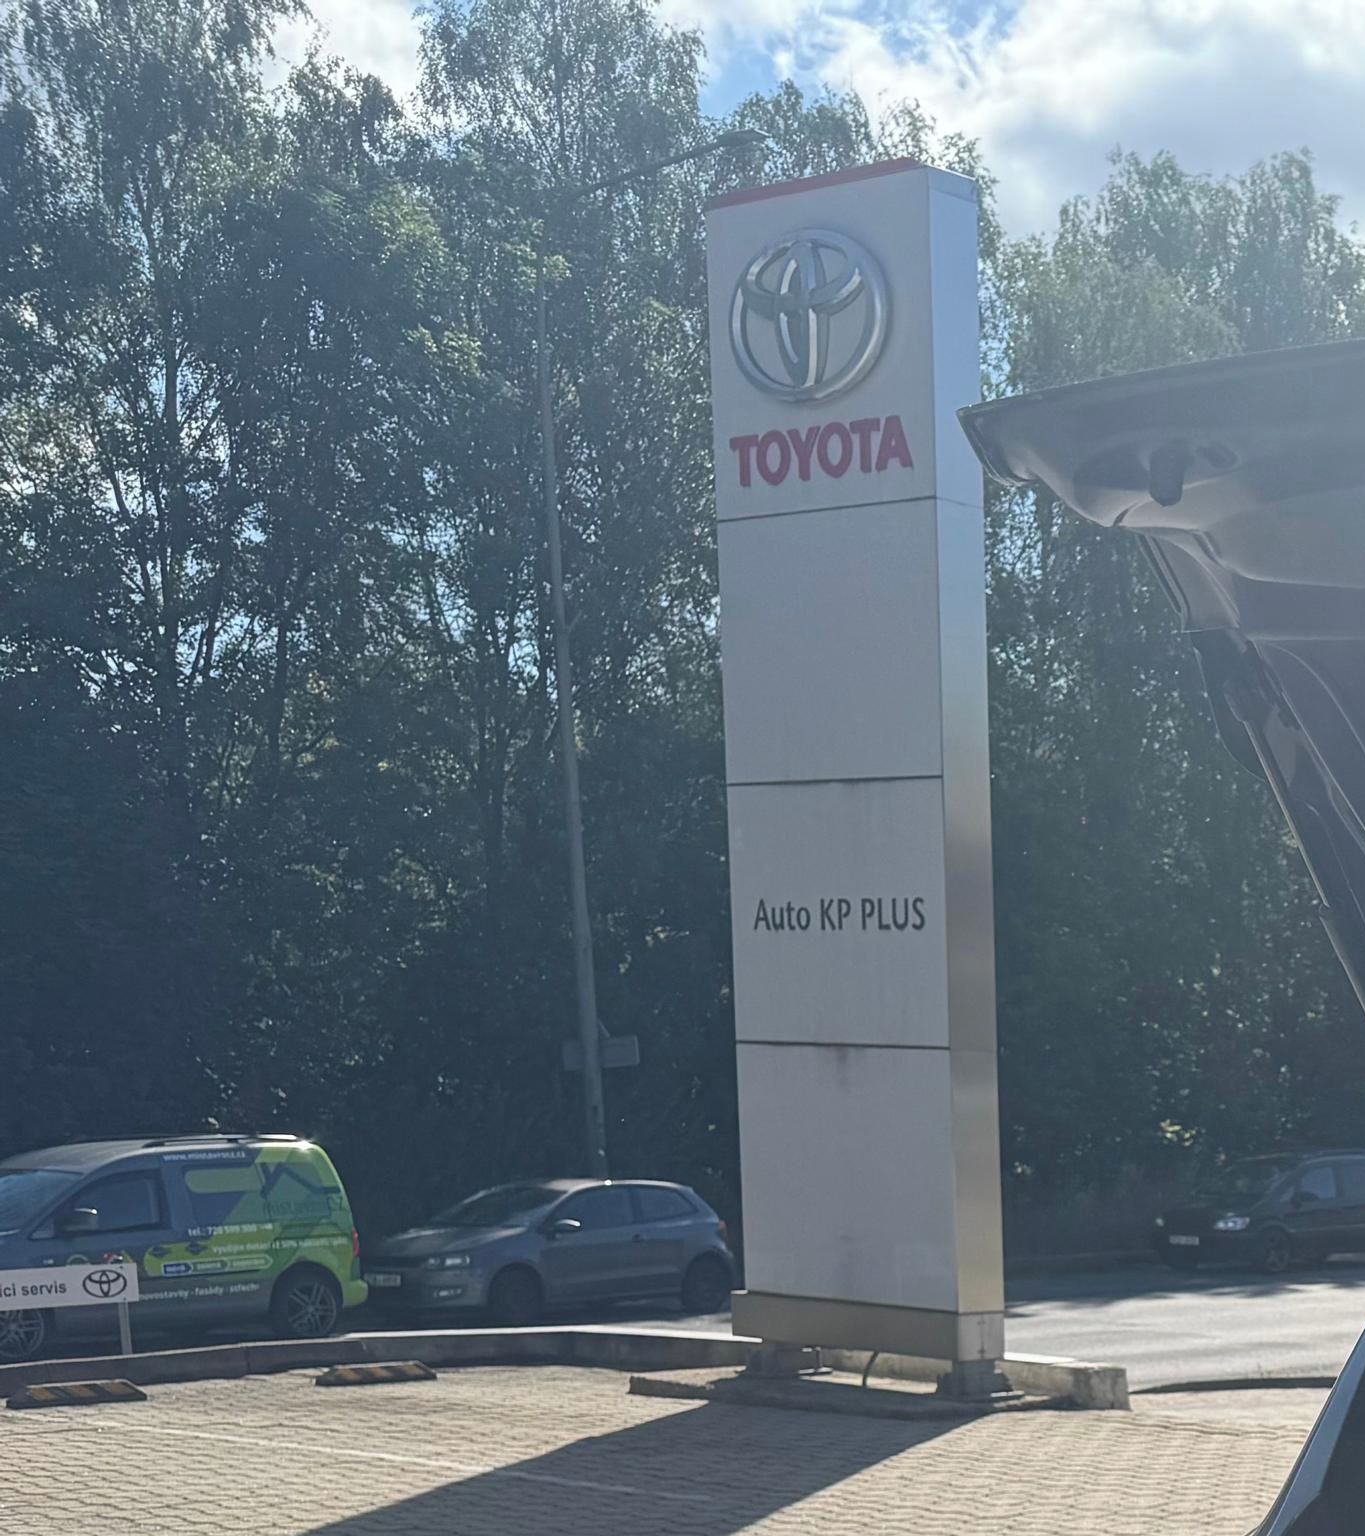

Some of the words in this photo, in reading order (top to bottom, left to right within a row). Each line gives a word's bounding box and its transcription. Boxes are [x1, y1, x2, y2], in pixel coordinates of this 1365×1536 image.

[729, 414, 913, 489] TOYOTA
[753, 898, 811, 931] Auto
[820, 898, 851, 931] KP
[860, 897, 926, 931] PLUS
[21, 1281, 67, 1297] servis
